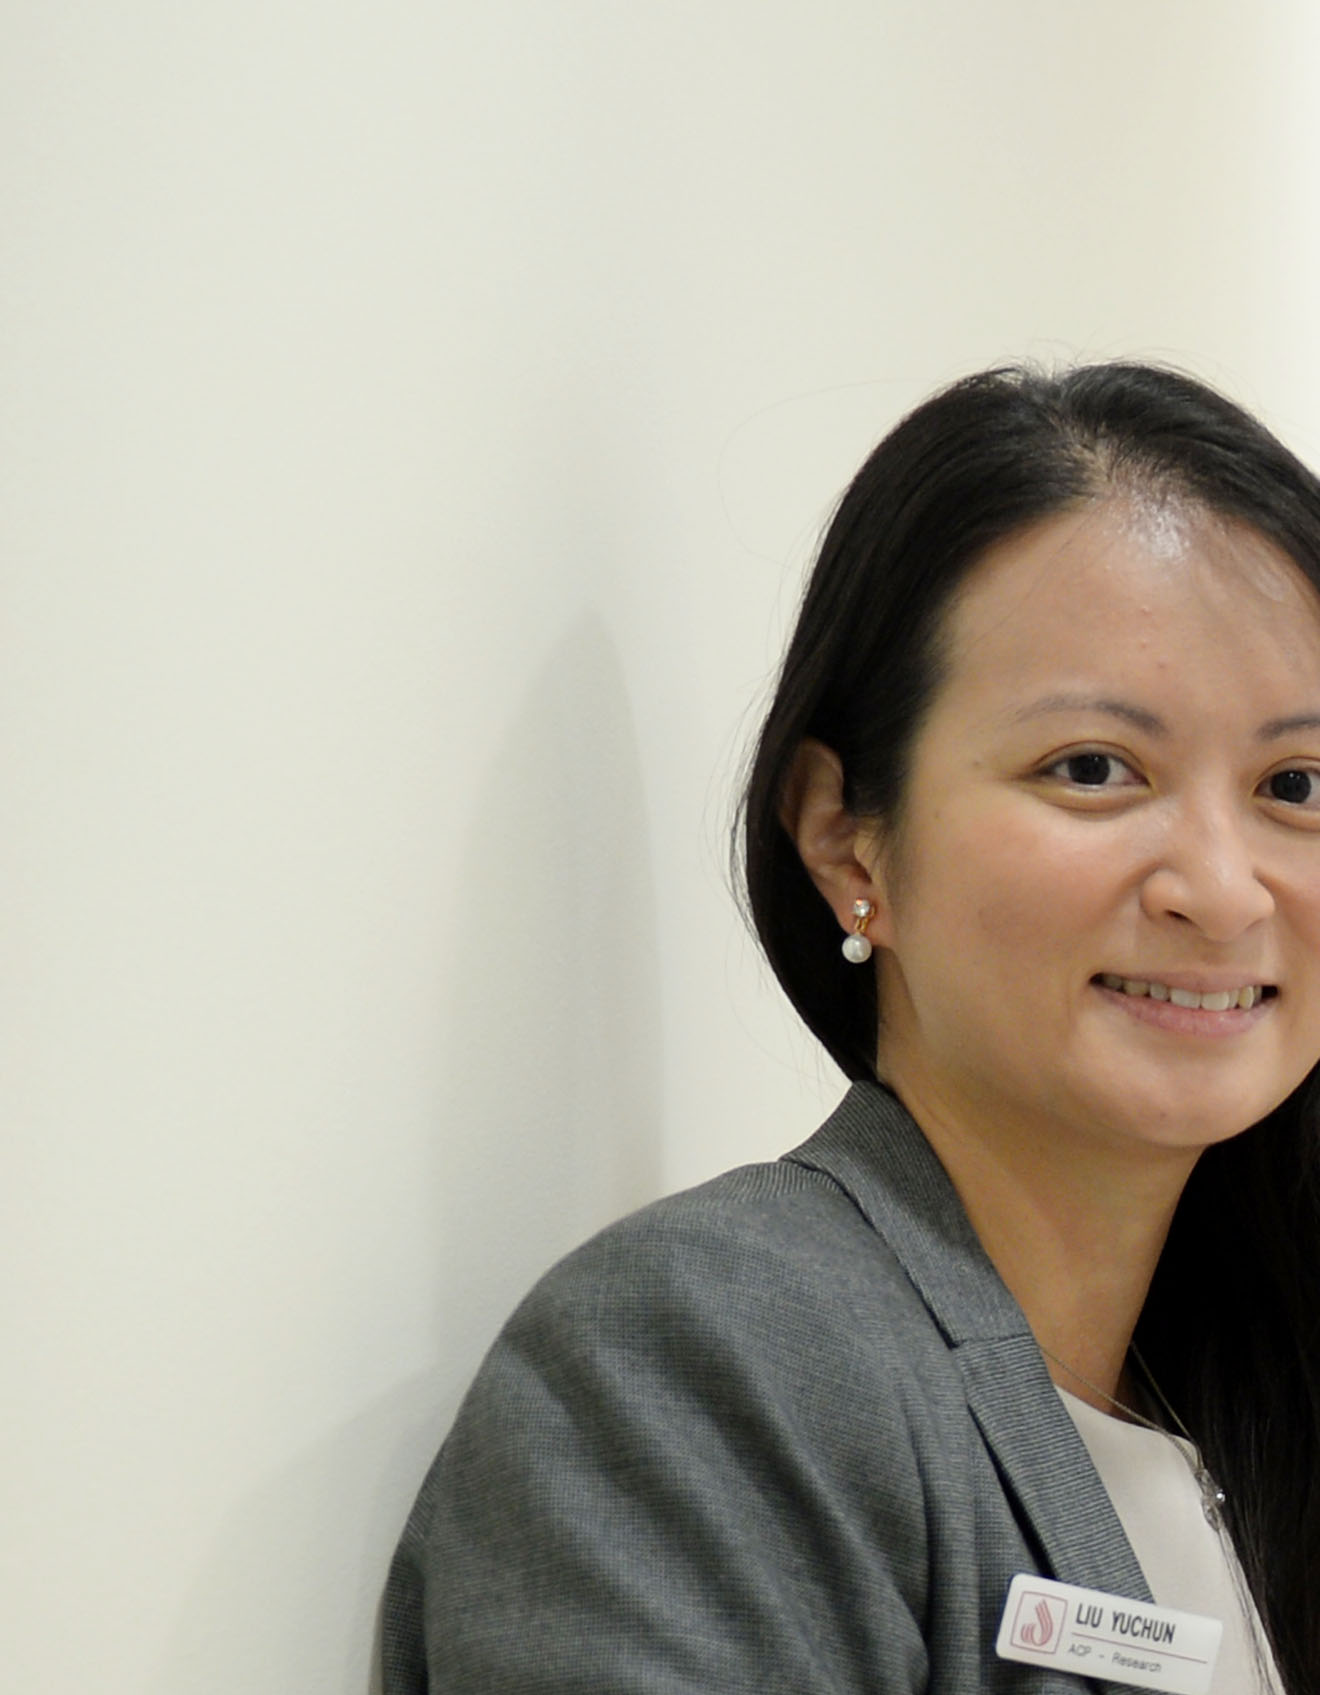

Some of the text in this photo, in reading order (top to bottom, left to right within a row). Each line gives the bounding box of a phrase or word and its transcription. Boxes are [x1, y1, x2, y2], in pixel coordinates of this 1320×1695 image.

[1076, 1603, 1175, 1644] LIU YUCHUN
[1111, 1651, 1162, 1672] Research
